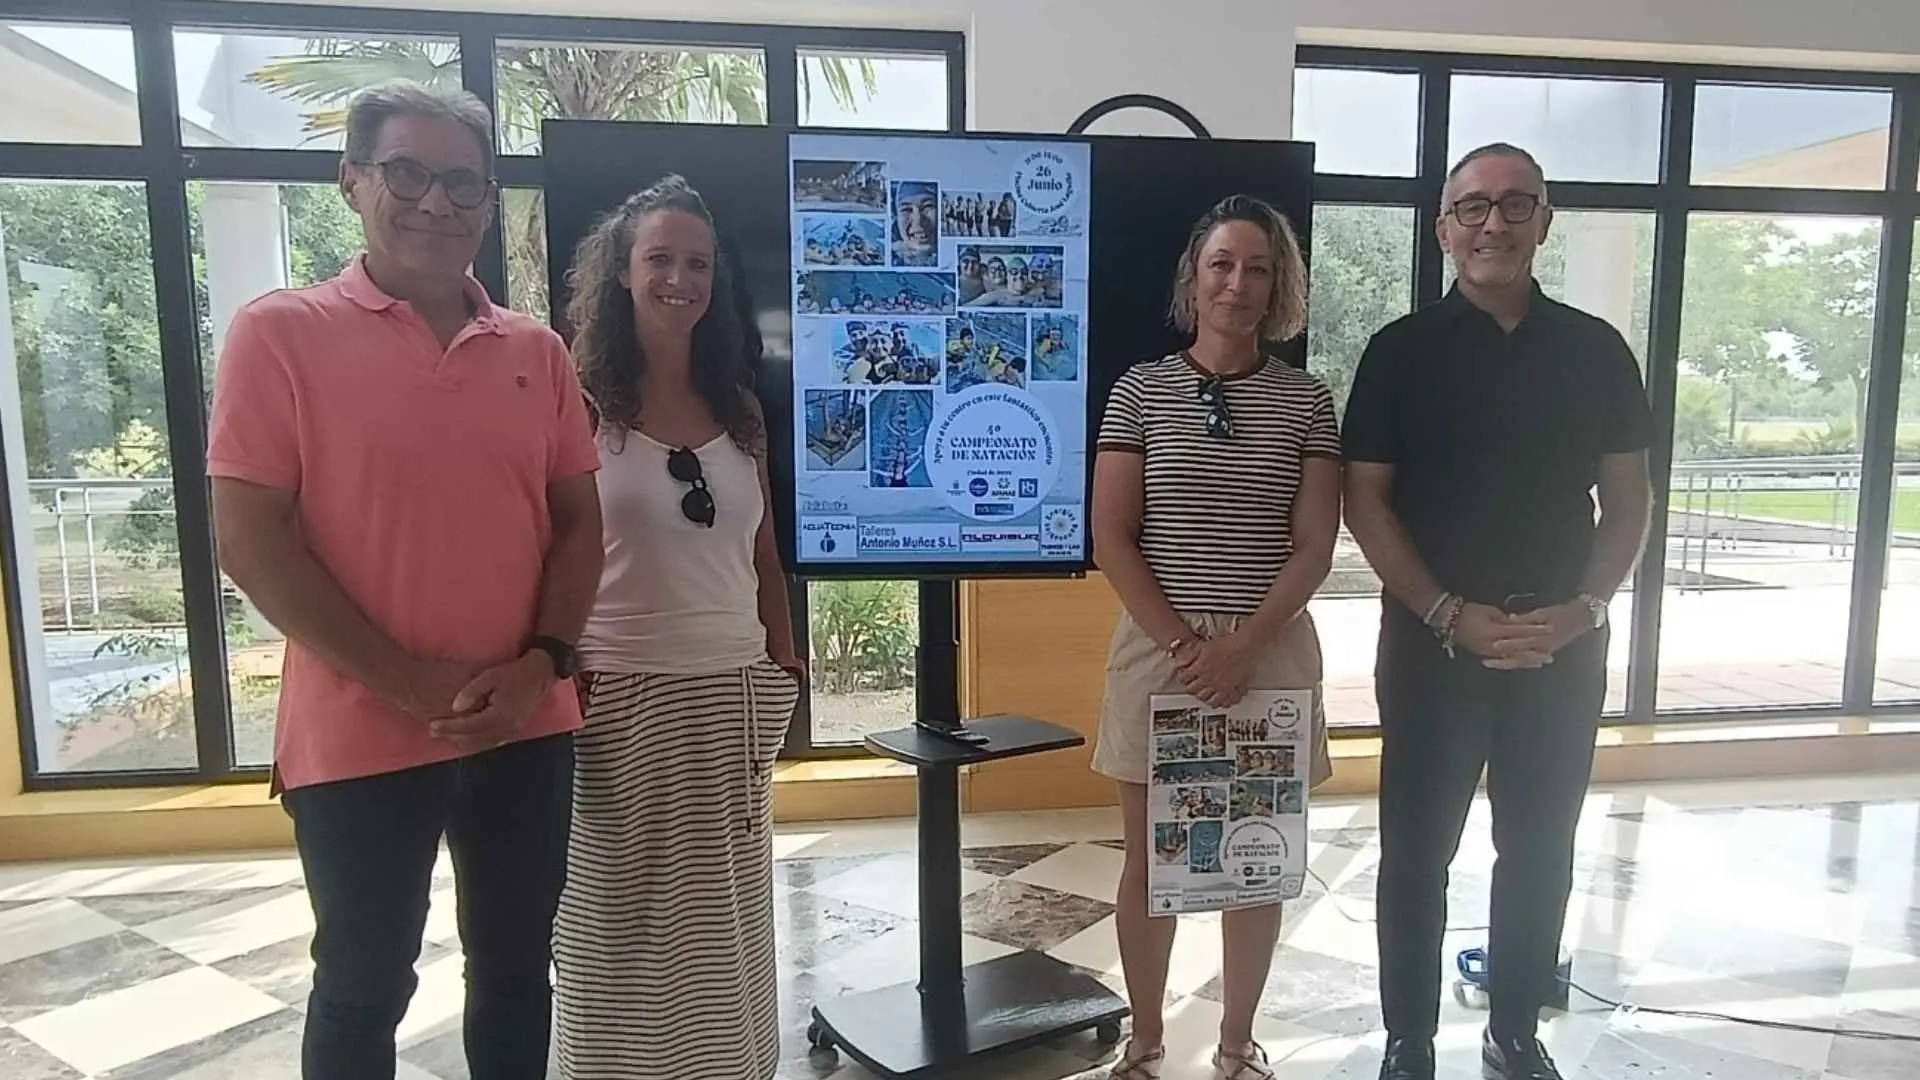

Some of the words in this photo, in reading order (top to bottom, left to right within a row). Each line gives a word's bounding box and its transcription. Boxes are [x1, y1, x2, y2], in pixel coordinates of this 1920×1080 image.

[1035, 166, 1052, 177] 26
[1027, 179, 1063, 191] Junio
[950, 437, 1037, 448] CAMPEONATO
[951, 450, 969, 461] DE
[861, 526, 896, 536] Talleres
[861, 538, 900, 548] Antonio
[902, 536, 936, 548] Muñoz
